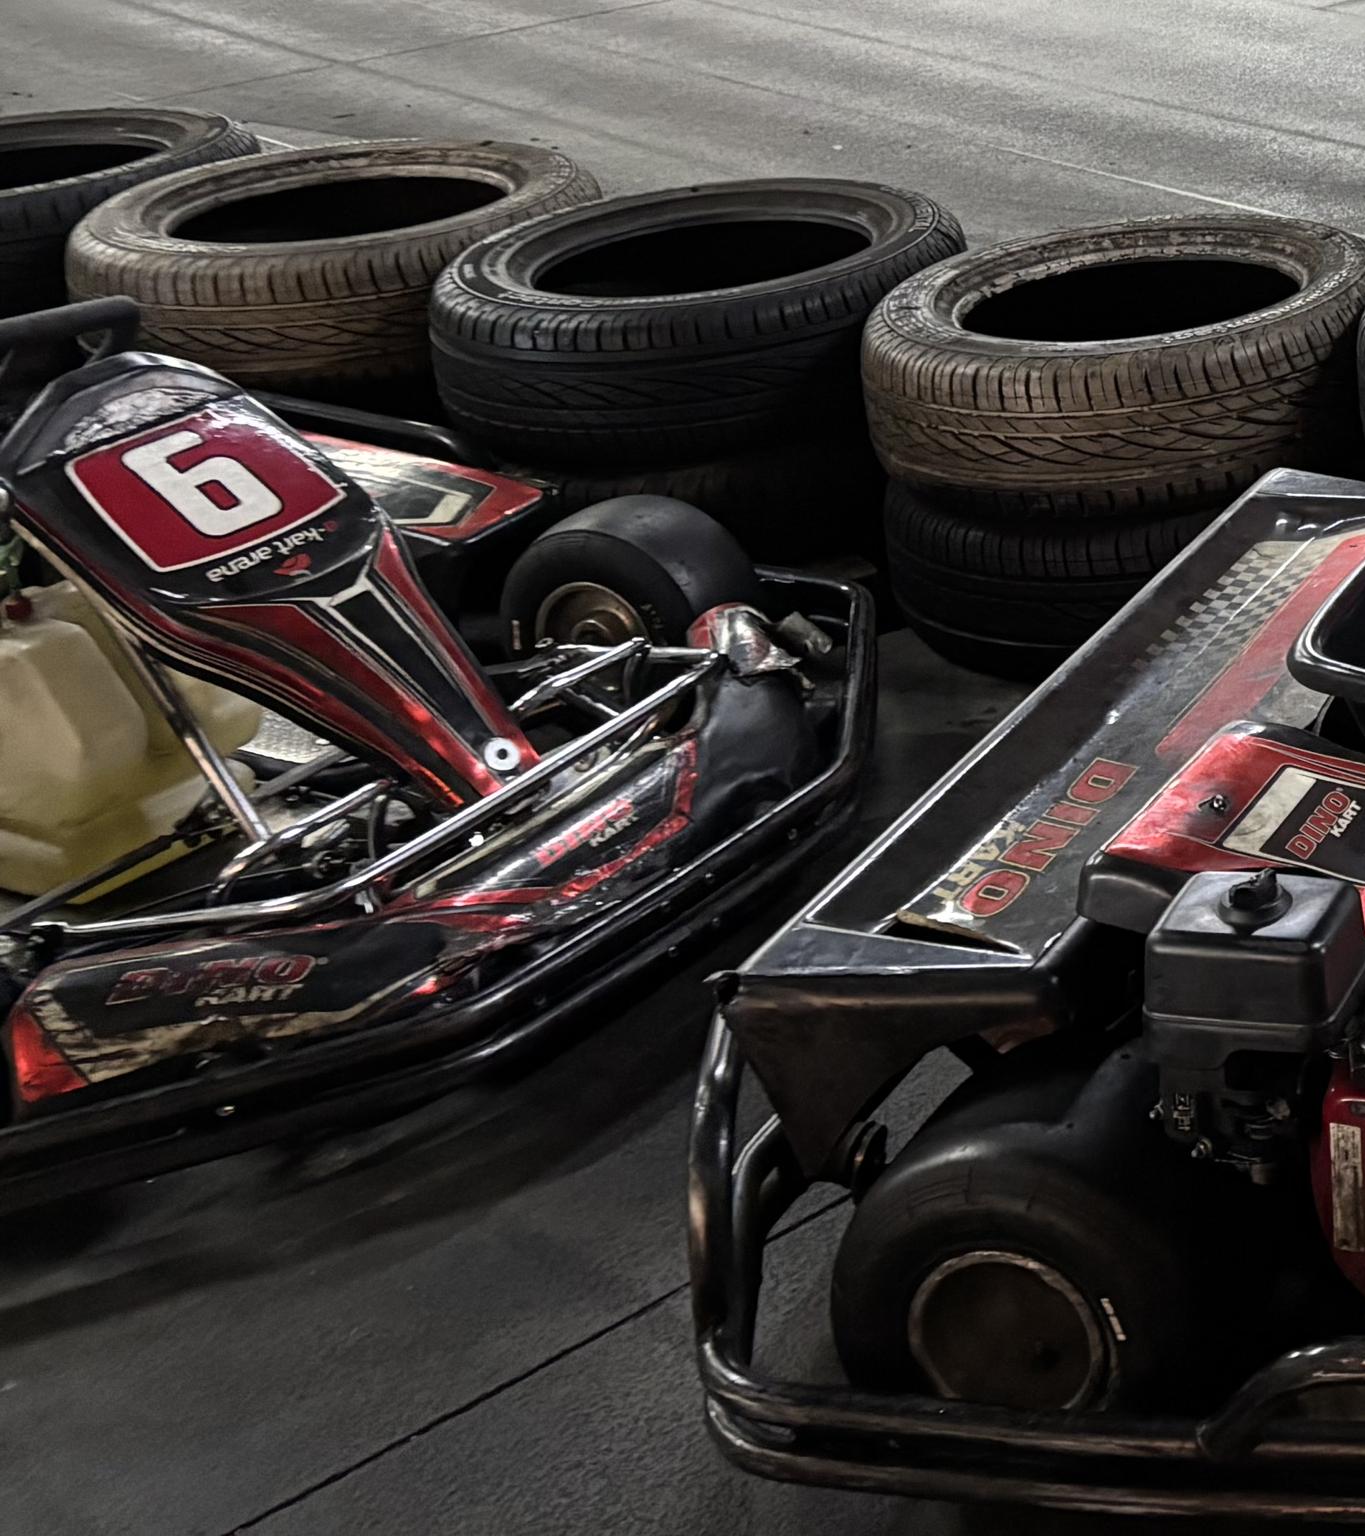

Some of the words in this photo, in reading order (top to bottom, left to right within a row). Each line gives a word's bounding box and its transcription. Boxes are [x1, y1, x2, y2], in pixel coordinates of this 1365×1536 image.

[121, 430, 283, 536] 6
[205, 549, 273, 582] arena
[957, 757, 1140, 917] DINO
[1285, 790, 1351, 860] DINO
[1329, 800, 1362, 838] KART
